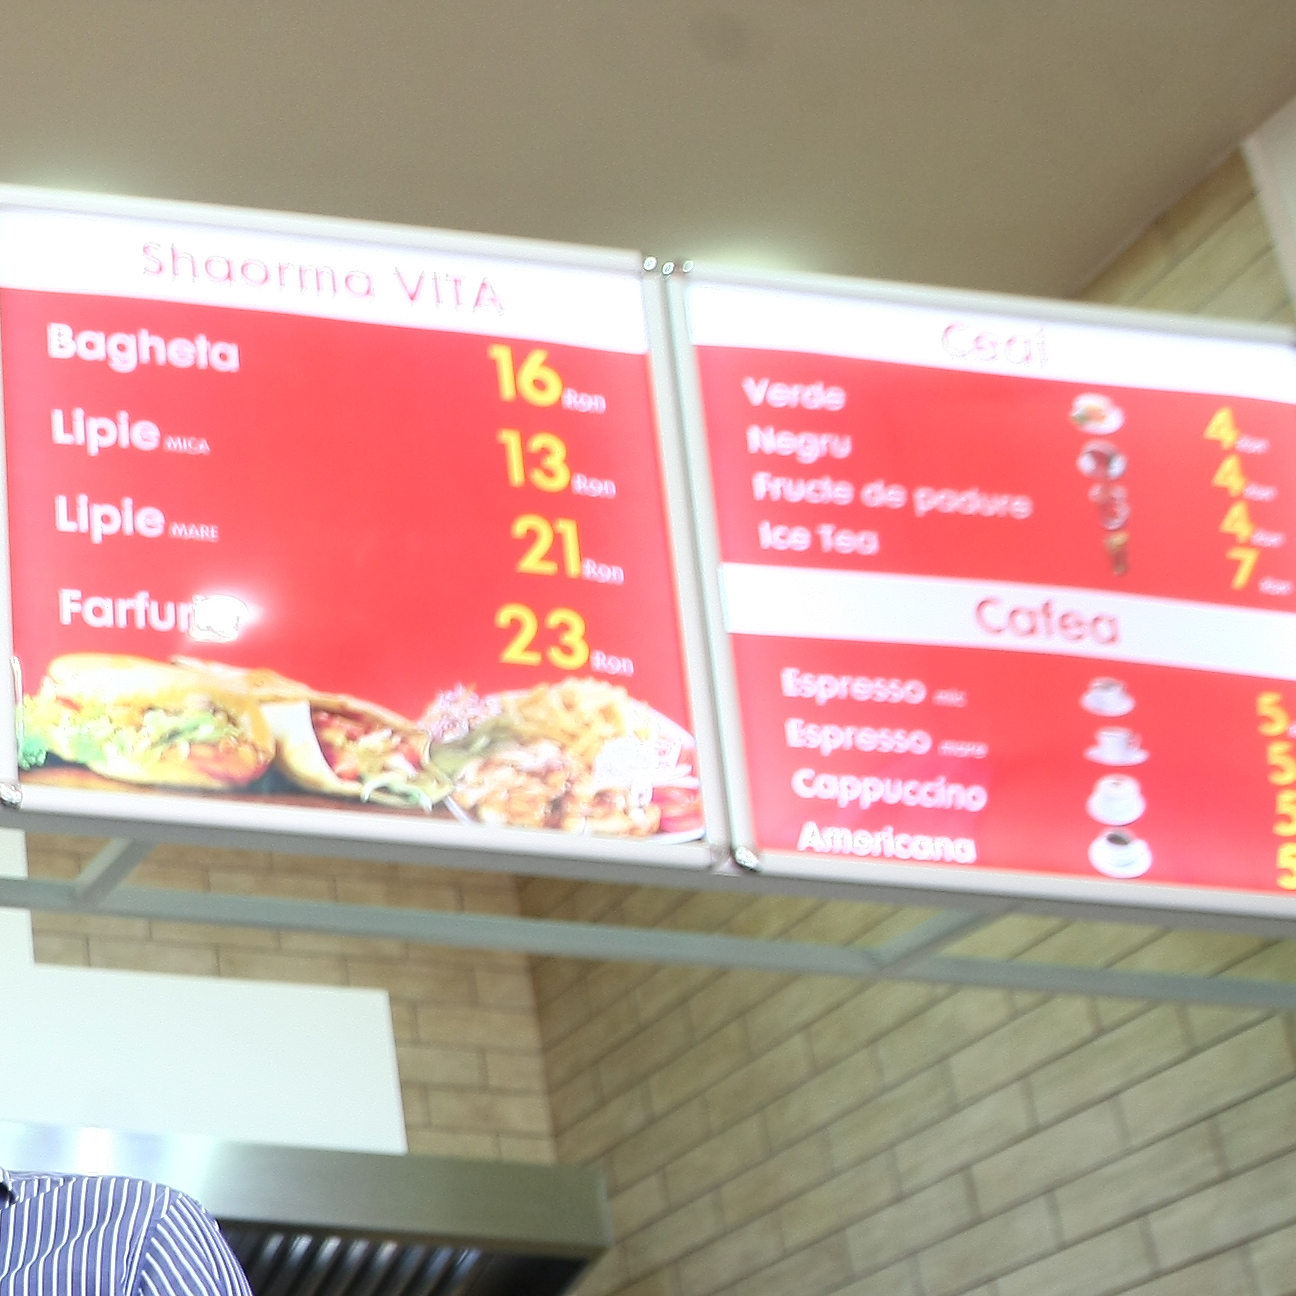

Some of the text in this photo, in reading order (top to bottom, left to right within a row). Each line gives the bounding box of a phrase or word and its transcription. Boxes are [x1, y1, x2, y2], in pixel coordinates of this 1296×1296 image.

[142, 242, 505, 316] Shaorma VITA
[46, 322, 240, 373] Bagheta
[487, 344, 563, 407] 16
[742, 376, 847, 411] Verde
[50, 407, 211, 456] Lipie MICA
[746, 424, 852, 464] Negru
[1203, 406, 1240, 451] 4
[497, 429, 617, 499] 13 Ron
[1211, 453, 1247, 498] 4
[55, 494, 219, 544] Lipie MARE
[860, 478, 908, 509] de
[912, 486, 1034, 520] padure
[758, 520, 812, 552] Ice
[1218, 500, 1254, 544] 4
[511, 514, 625, 586] 21 Ron
[1225, 545, 1259, 590] 7
[59, 589, 238, 637] Farfur
[975, 597, 1119, 645] Cafea
[494, 603, 634, 677] 23 Ron
[780, 667, 927, 706] Espresso
[1256, 691, 1289, 736] 5
[785, 718, 933, 757] Espresso
[1266, 740, 1296, 786] 5
[791, 768, 988, 812] Cappuccino
